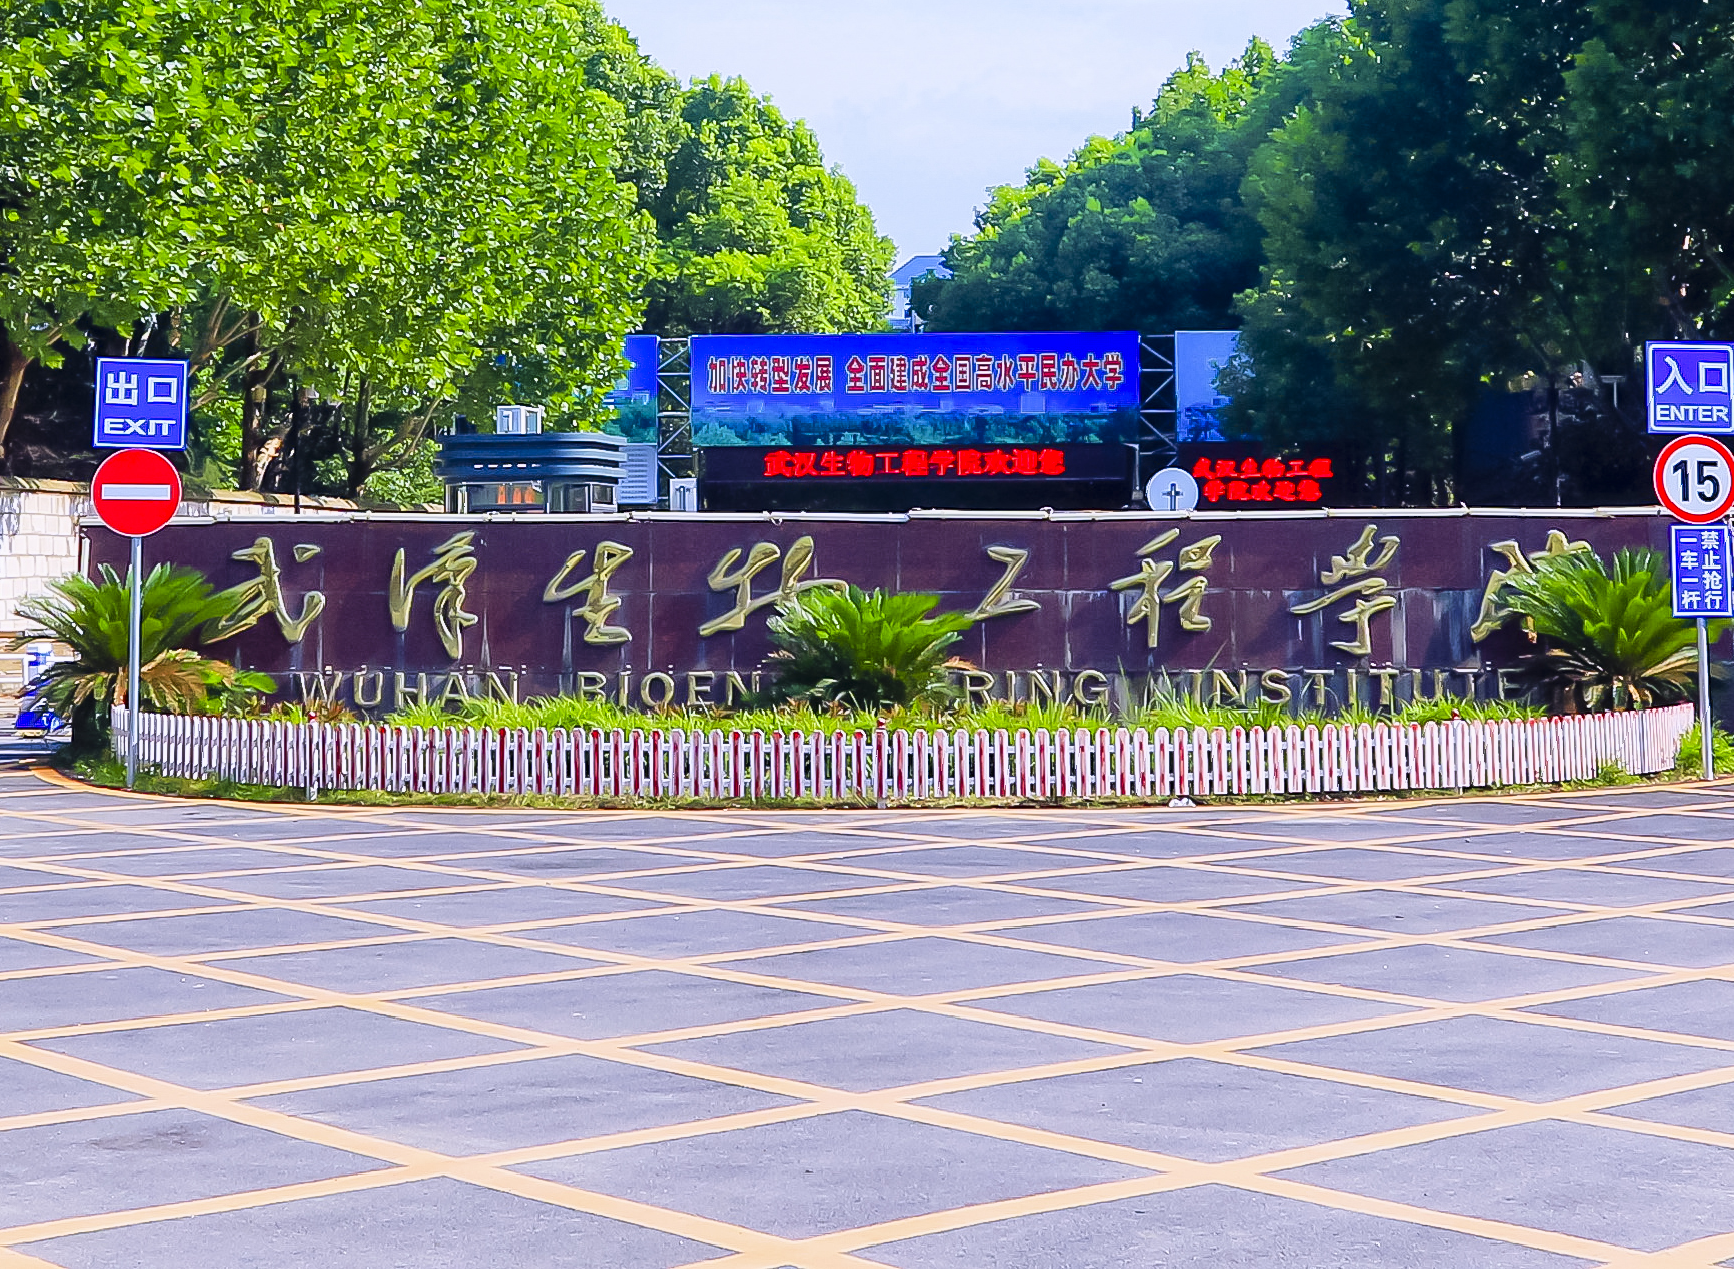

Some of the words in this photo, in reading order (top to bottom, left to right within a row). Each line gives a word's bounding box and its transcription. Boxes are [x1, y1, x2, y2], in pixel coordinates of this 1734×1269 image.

[105, 371, 178, 406] 出口
[707, 354, 834, 394] 加快转型发展
[845, 353, 1124, 393] 全面建成全国高水平民办大学
[1656, 355, 1729, 396] 入口
[103, 418, 177, 436] EXIT
[1656, 404, 1729, 423] ENTER
[763, 449, 1066, 477] 武汉生物工程学院欢迎您
[1672, 459, 1722, 502] 15
[1680, 536, 1701, 610] 一车一杆
[1701, 531, 1723, 610] 禁止抢行
[293, 671, 519, 709] WUHAN
